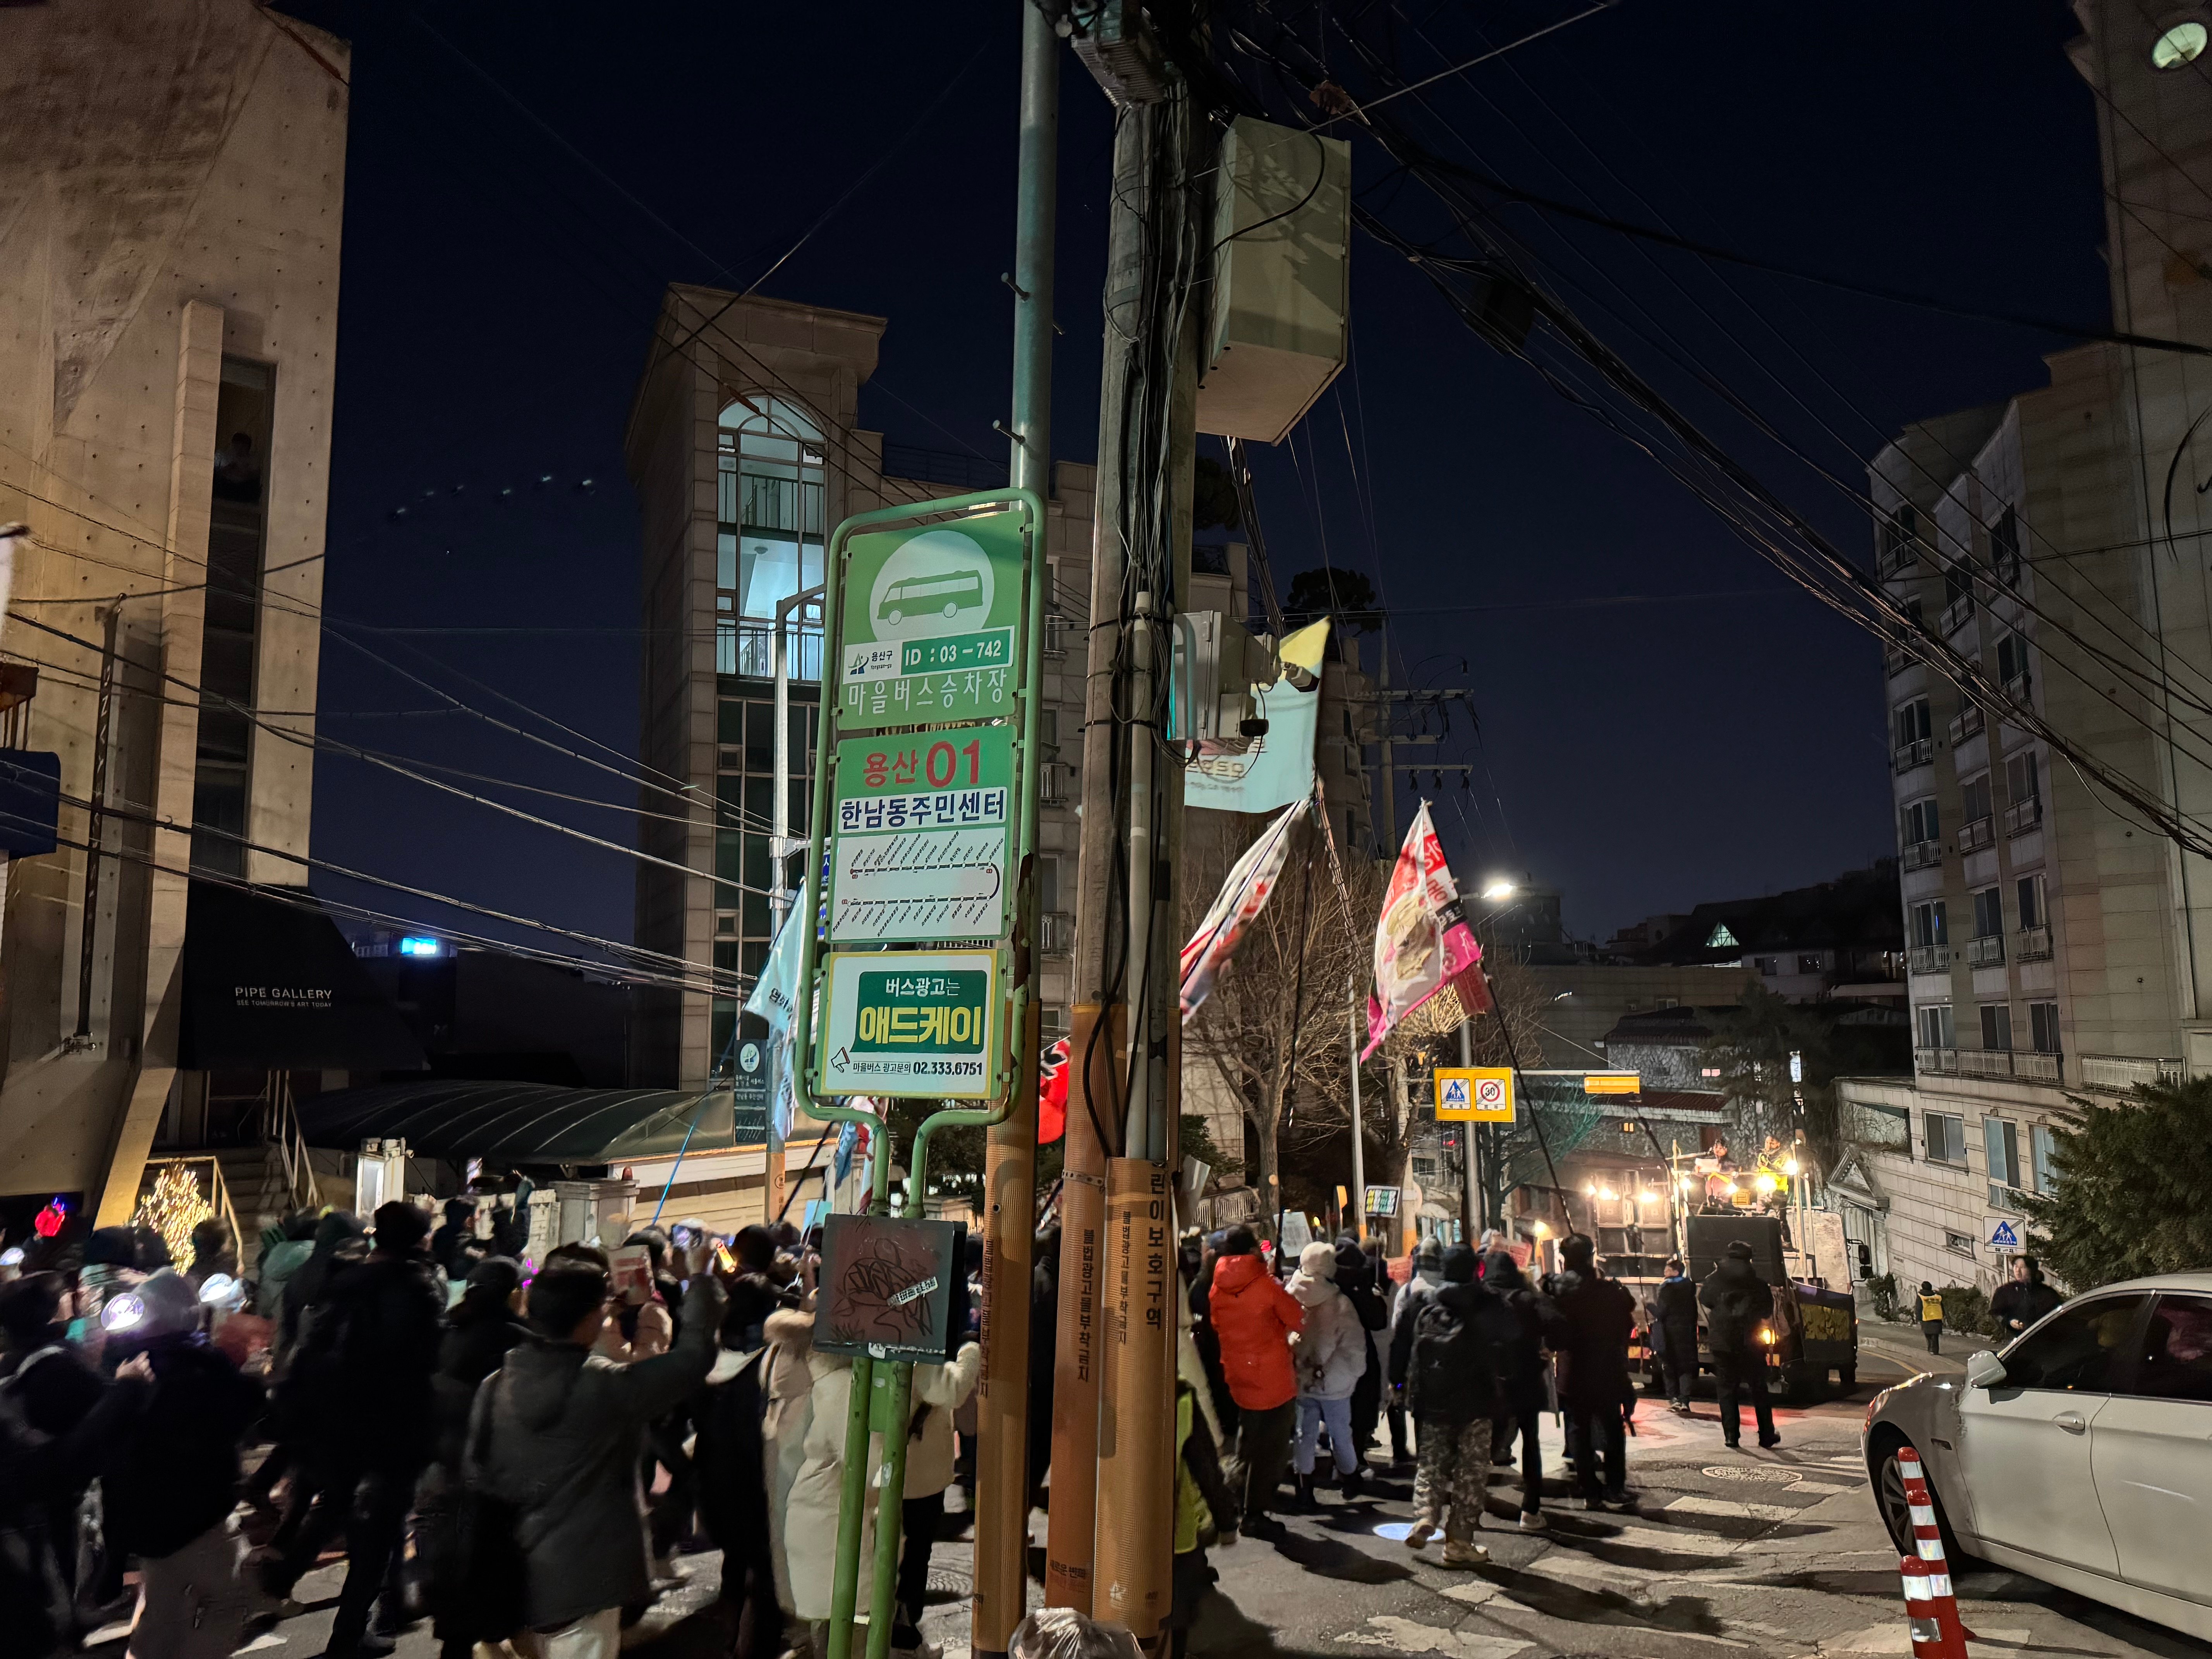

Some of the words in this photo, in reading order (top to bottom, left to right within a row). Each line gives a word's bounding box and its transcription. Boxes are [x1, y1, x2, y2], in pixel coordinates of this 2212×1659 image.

[905, 649, 921, 666] ID
[848, 670, 1007, 716] 마을버스승차장
[842, 790, 1004, 830] 한남동주민센터
[235, 987, 266, 998] PIPE
[272, 988, 331, 999] GALLERY
[886, 977, 960, 997] 버스광고는
[859, 1006, 981, 1045] 애드케이
[853, 1063, 881, 1072] 마을버스
[883, 1062, 911, 1073] 광고문의
[913, 1061, 982, 1075] 02.333.6751
[1485, 1087, 1495, 1096] 30
[1147, 1162, 1166, 1331] 린이보호구역
